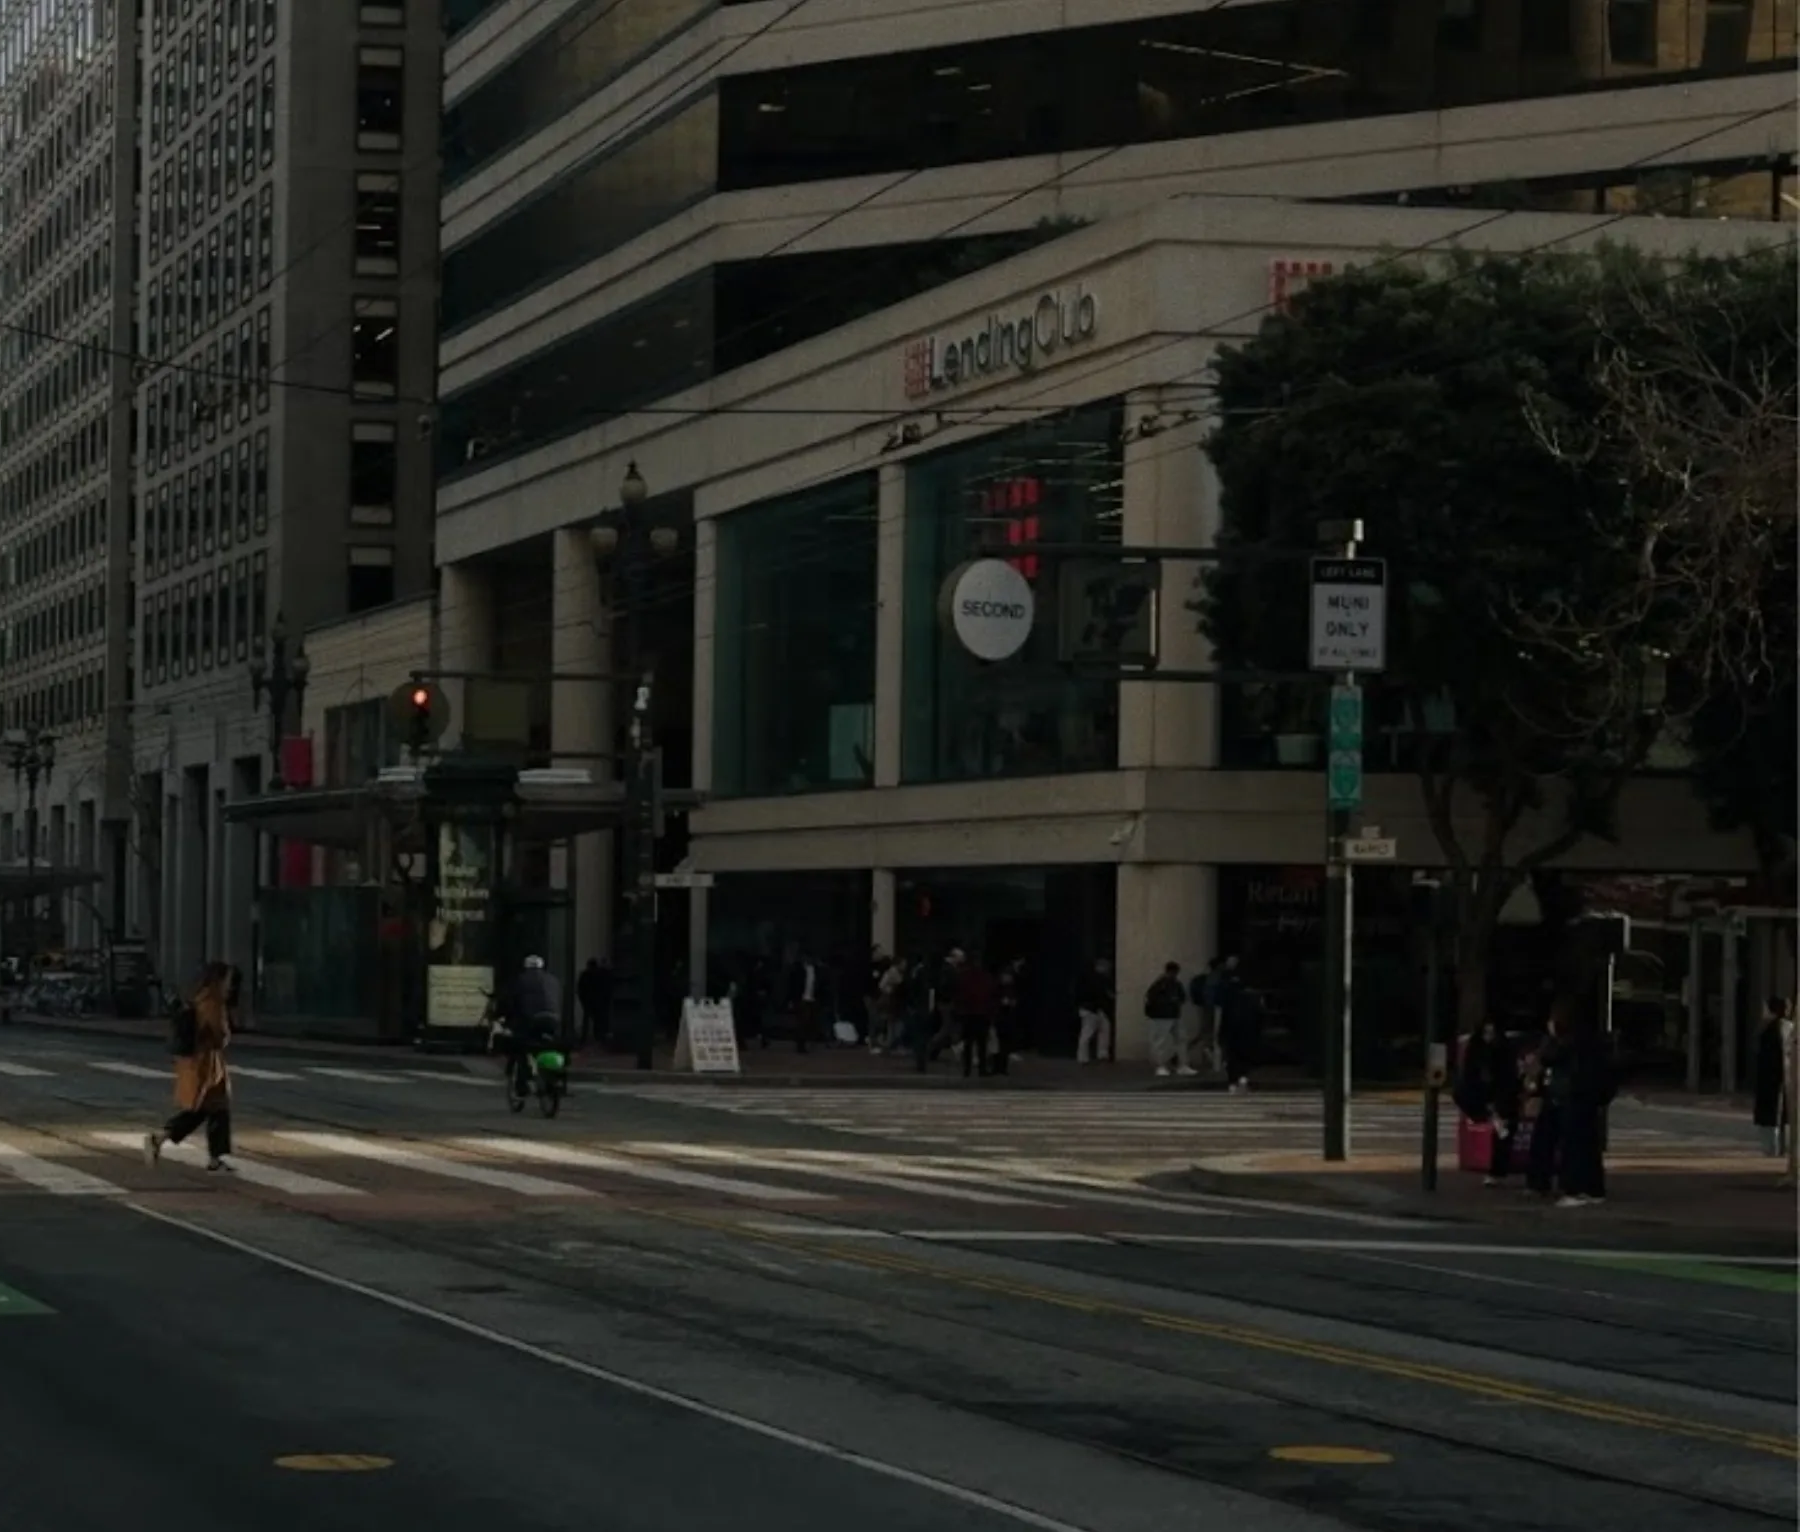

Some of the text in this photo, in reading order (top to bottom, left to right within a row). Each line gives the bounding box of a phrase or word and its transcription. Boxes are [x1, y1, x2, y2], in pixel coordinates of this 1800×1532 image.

[929, 283, 1095, 390] LendingClub
[961, 599, 1026, 620] SECOND
[1327, 594, 1370, 610] MUNI
[1326, 620, 1370, 638] ONLY
